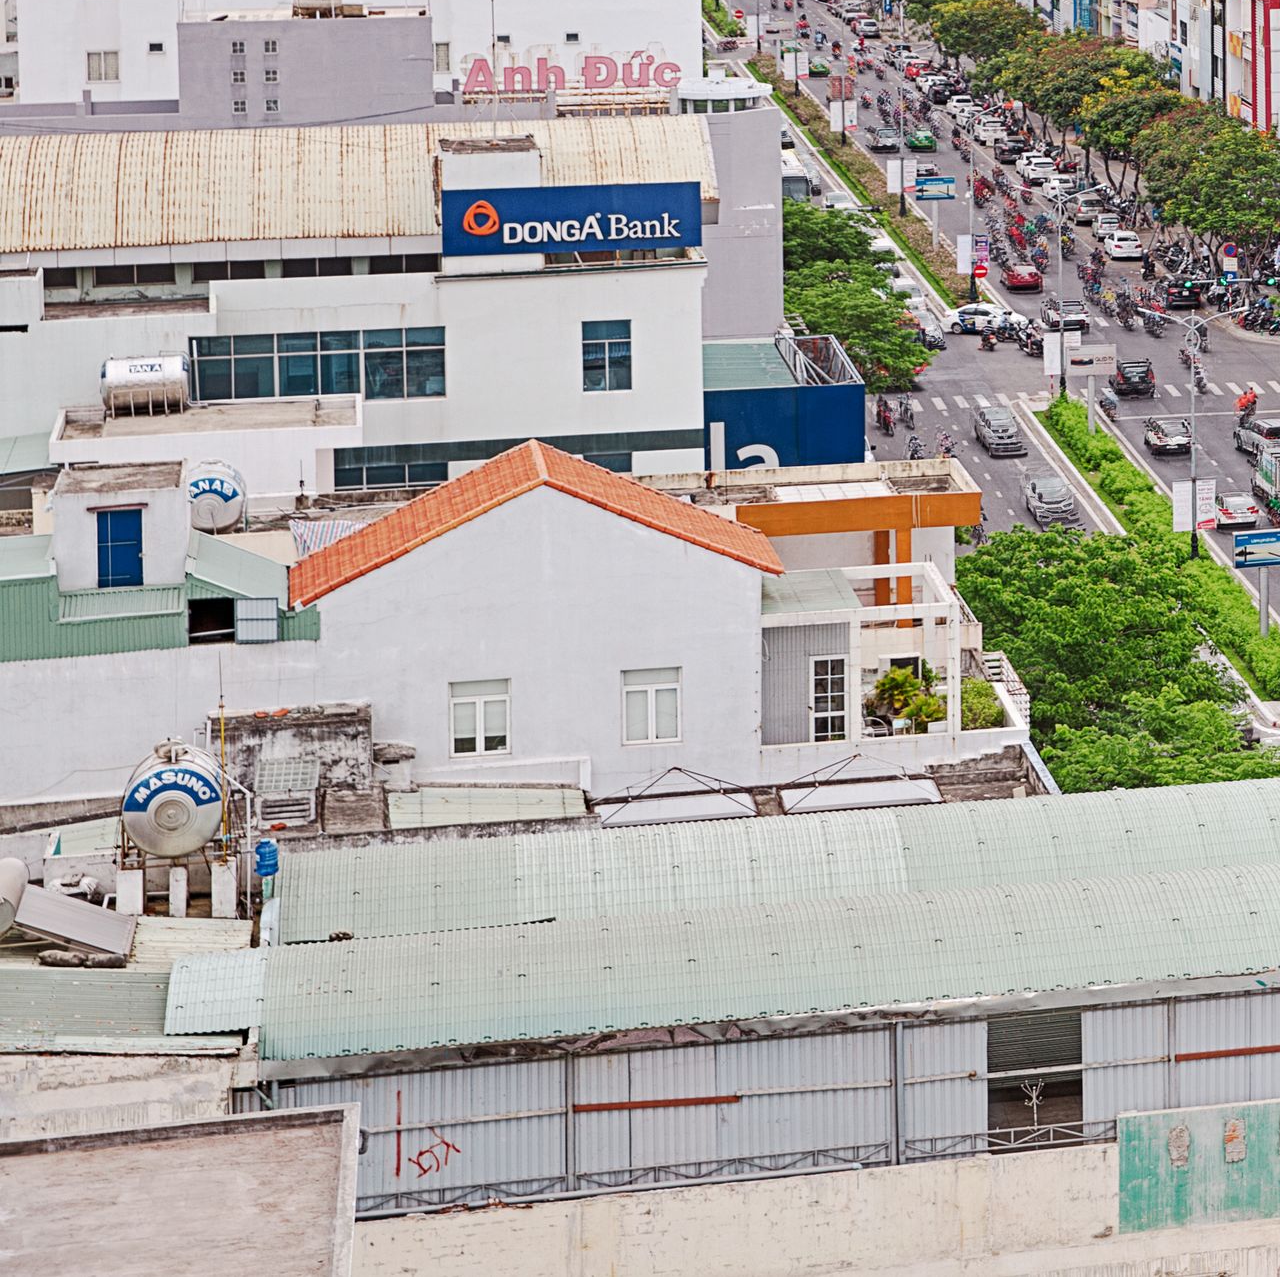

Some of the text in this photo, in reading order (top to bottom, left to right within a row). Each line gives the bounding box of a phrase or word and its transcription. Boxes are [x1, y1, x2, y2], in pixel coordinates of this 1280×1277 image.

[463, 50, 682, 92] Anh Đức
[607, 213, 682, 240] Bank
[134, 771, 211, 804] MASUNO
